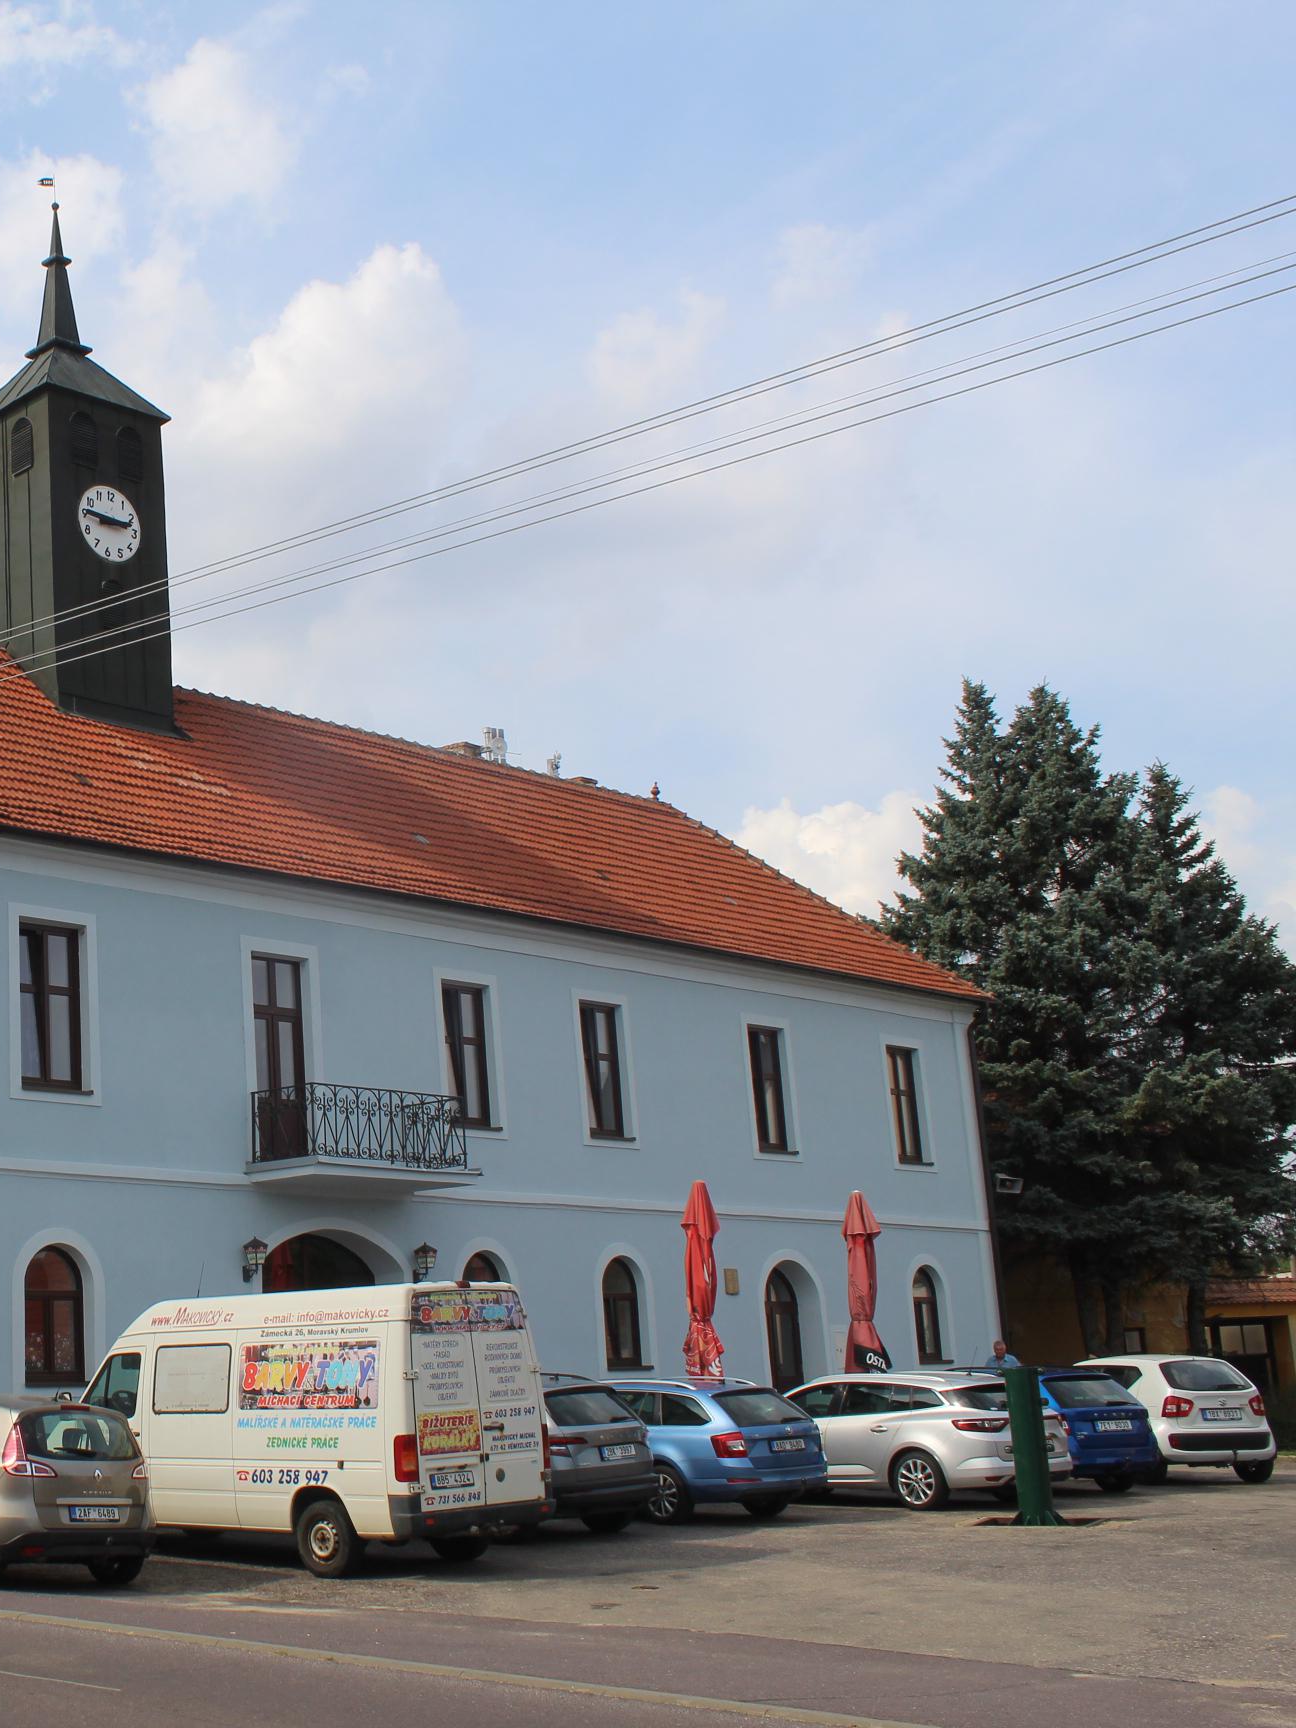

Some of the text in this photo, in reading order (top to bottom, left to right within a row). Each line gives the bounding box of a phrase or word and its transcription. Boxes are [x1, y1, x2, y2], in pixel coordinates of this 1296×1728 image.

[96, 490, 102, 502] 11
[107, 491, 115, 503] 12
[86, 497, 94, 508] 10
[121, 501, 124, 511] 1
[82, 508, 88, 518] 9
[84, 525, 91, 535] 8
[131, 529, 137, 540] 3
[94, 538, 100, 548] 7
[126, 543, 133, 552] 4
[104, 547, 111, 557] 6
[117, 548, 124, 559] 5
[263, 1308, 390, 1325] e-mail: info@makovicky.cz
[295, 1328, 306, 1337] 26,
[307, 1327, 339, 1336] Moravský
[340, 1325, 369, 1335] Krumlov
[243, 1361, 312, 1391] BARVY
[304, 1394, 356, 1407] CENTRUM
[495, 1409, 507, 1418] 603
[510, 1408, 521, 1417] 258
[280, 1418, 286, 1428] A
[422, 1414, 474, 1428] BIŽUTERIE
[252, 1469, 329, 1486] 603 258 947
[454, 1472, 471, 1483] 4324
[438, 1495, 450, 1505] 731
[452, 1493, 465, 1504] 566
[78, 1508, 116, 1518] 2AF 6489
